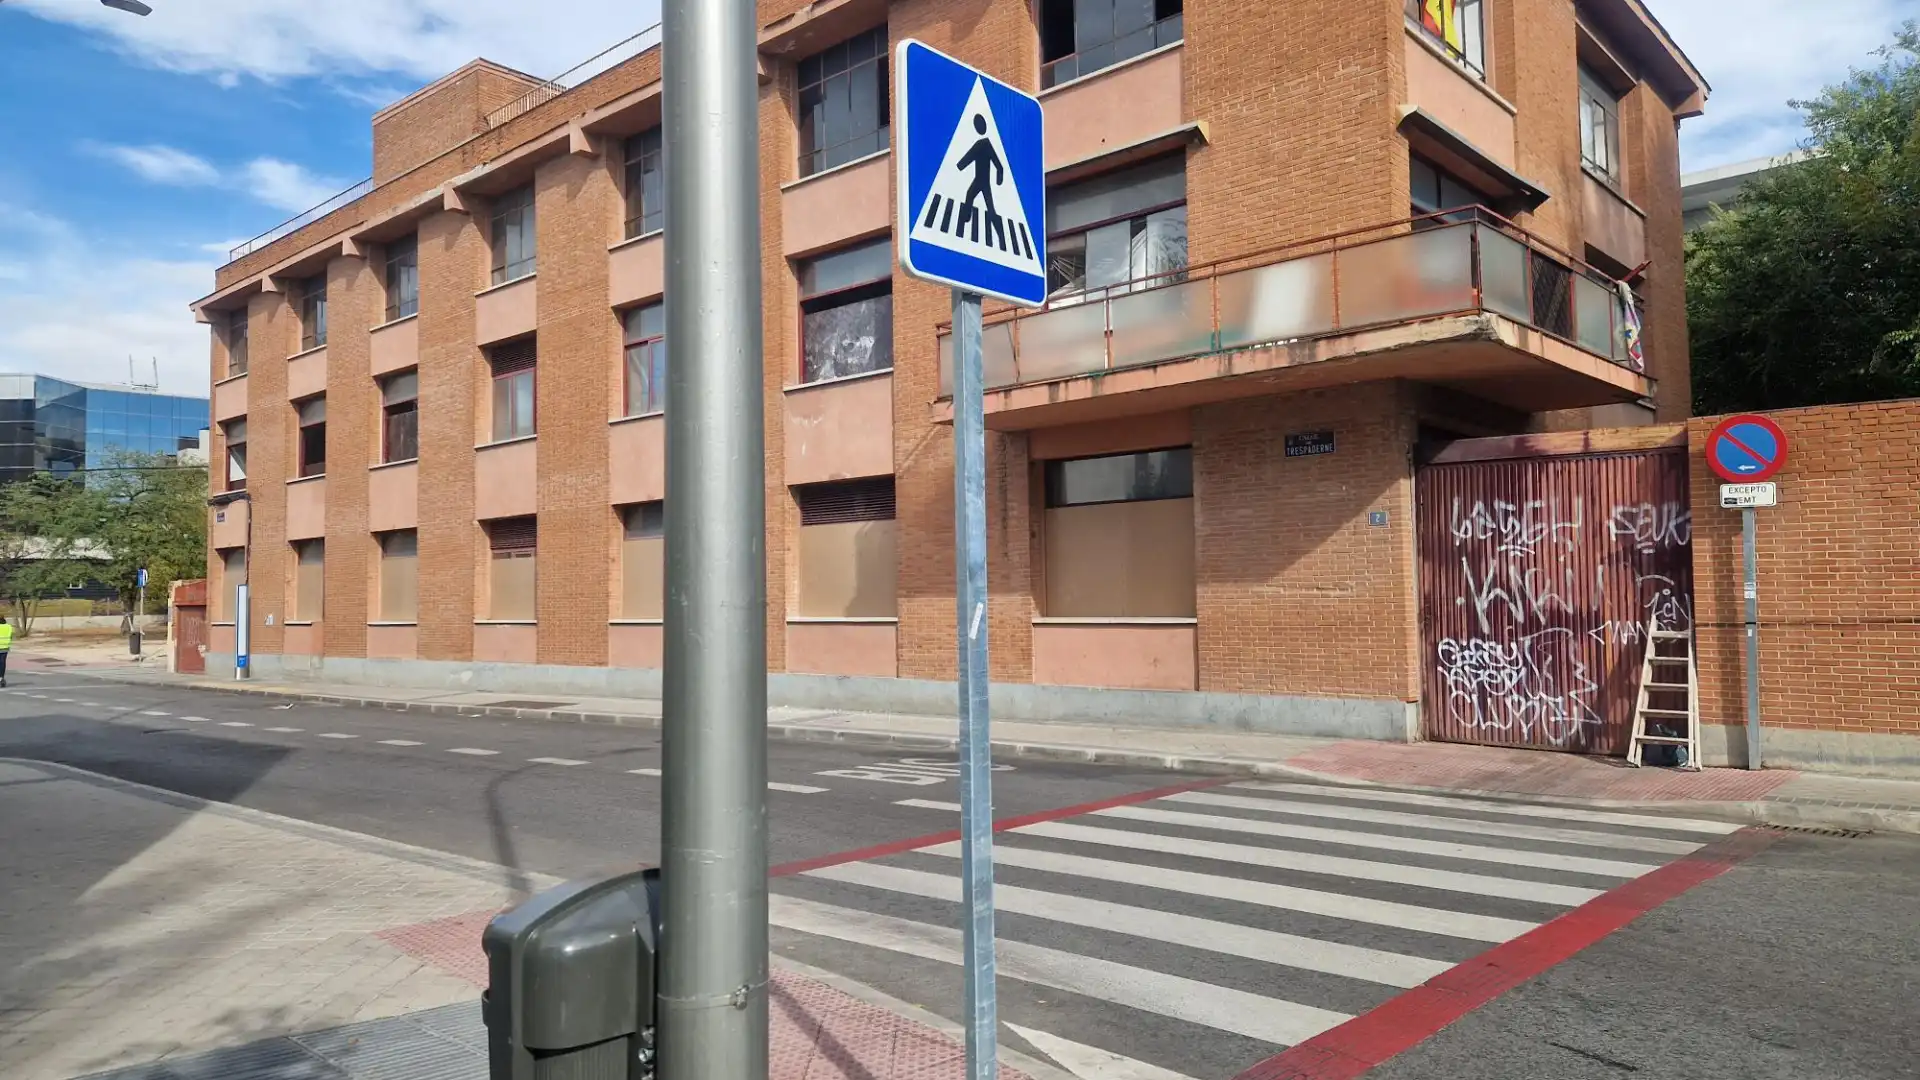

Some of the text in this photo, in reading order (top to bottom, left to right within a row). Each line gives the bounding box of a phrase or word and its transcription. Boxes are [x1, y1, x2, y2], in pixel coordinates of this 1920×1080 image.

[1287, 443, 1333, 456] TRESPADERNE
[1728, 485, 1767, 494] EXCEPTO
[1738, 496, 1757, 504] EMT
